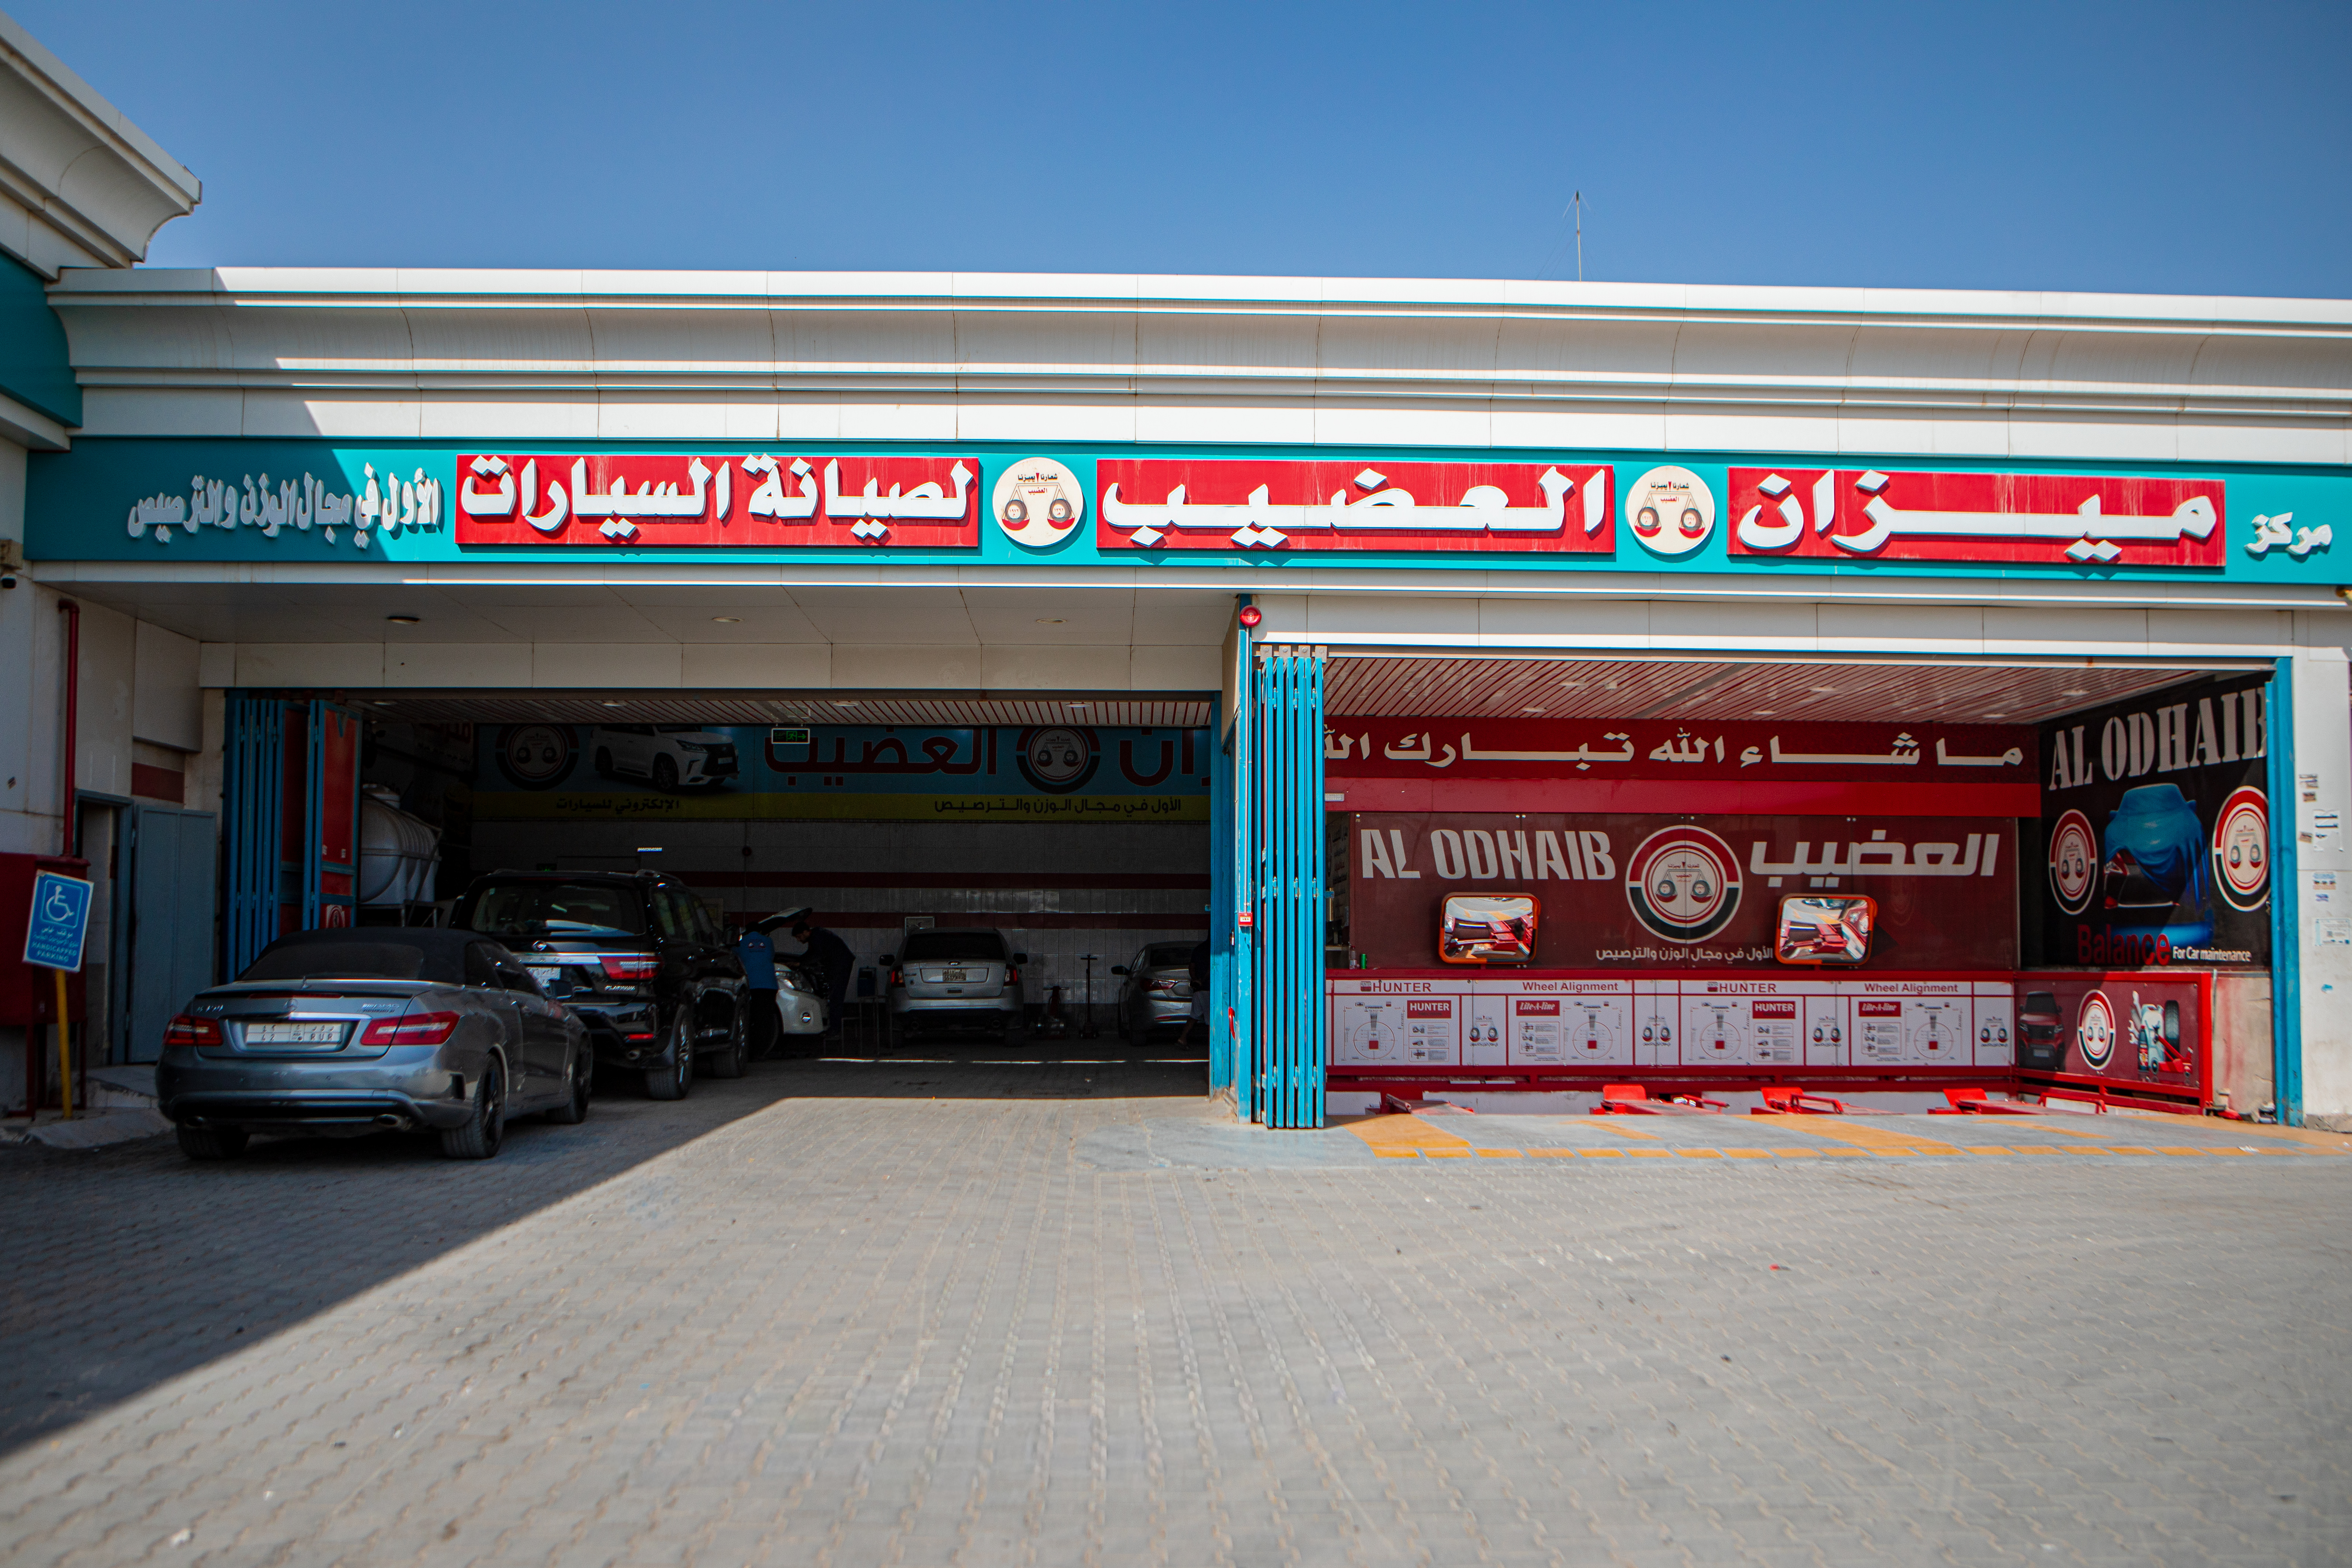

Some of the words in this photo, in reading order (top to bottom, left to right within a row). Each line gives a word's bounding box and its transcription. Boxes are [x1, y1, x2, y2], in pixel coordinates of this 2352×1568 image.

[128, 475, 238, 543] والترصيص
[240, 473, 298, 537] الوزن
[297, 472, 353, 545] مجال
[354, 462, 380, 550] في
[381, 467, 439, 531] الأول
[461, 455, 730, 539] السيارات
[741, 453, 974, 539] لصيانة
[1028, 487, 1047, 495] العضيب
[1103, 466, 1605, 548] العضيب
[1738, 469, 2217, 562] ميزان
[2244, 511, 2333, 555] مركز
[1324, 724, 1370, 760] الل
[1384, 732, 1635, 771] تبارك
[1649, 727, 1725, 764] الله
[1739, 732, 1920, 768] شاء
[1935, 738, 2024, 766] ما
[2048, 725, 2093, 791] AL
[2101, 686, 2267, 781] ODHAIB
[1034, 798, 1071, 814] الوزن
[1074, 798, 1120, 814] مجال
[1124, 798, 1148, 817] في
[1151, 797, 1181, 813] الأول
[1361, 829, 1421, 879] AL
[1430, 829, 1616, 880] ODHAIB
[1749, 829, 2000, 888] العضيب
[1596, 946, 1658, 960] والترصيص
[1659, 947, 1689, 961] الوزن
[1691, 947, 1722, 961] مجال
[1724, 947, 1743, 964] في
[1746, 945, 1773, 961] الأول
[2078, 924, 2171, 966] Balance
[2173, 946, 2186, 959] For
[2186, 946, 2200, 960] Car
[2200, 947, 2252, 962] maintenance
[1373, 982, 1432, 992] HUNTER
[1523, 982, 1557, 991] Wheel
[1560, 982, 1618, 993] Alignment
[1719, 983, 1777, 992] HUNTER
[1864, 983, 1899, 992] Wheel
[1901, 983, 1958, 995] Alignment
[1410, 1003, 1450, 1011] HUNTER
[1755, 1003, 1794, 1011] HUNTER
